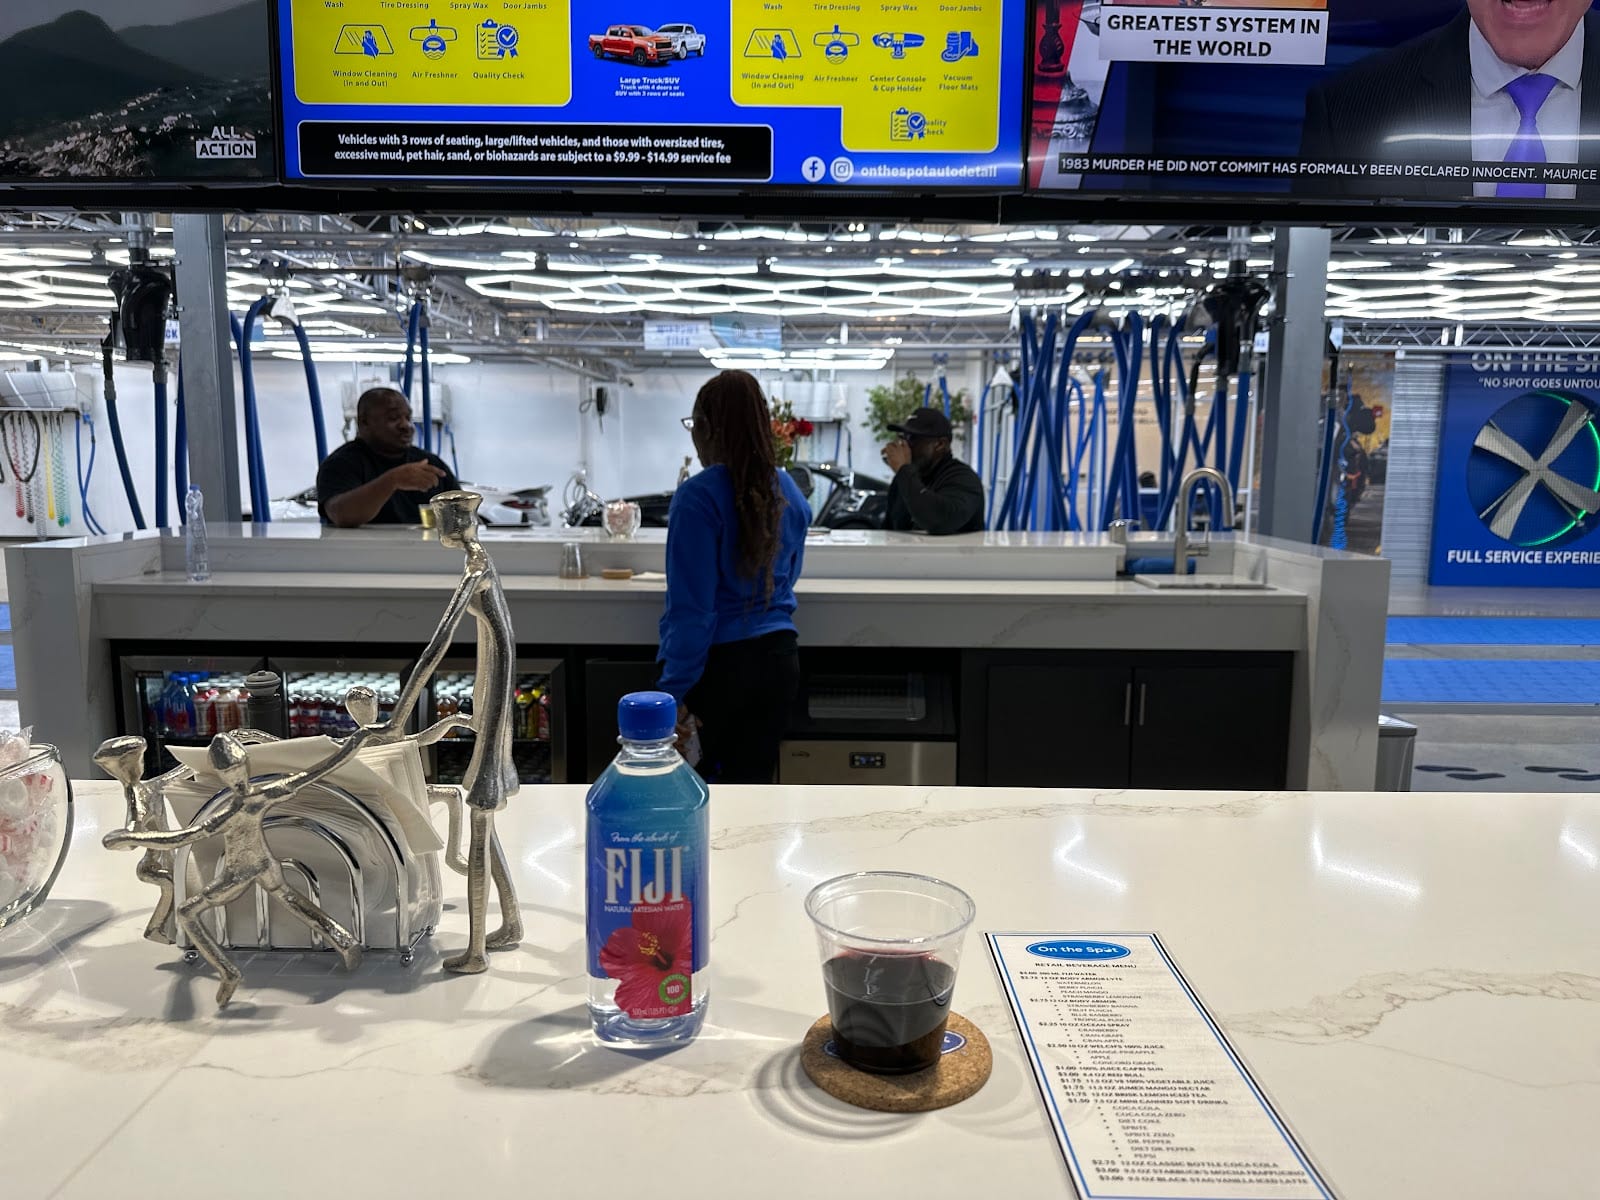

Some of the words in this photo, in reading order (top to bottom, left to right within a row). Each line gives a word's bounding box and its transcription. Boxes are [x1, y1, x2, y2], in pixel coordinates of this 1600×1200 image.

[396, 1, 429, 11] Dressing
[450, 2, 470, 11] Spray
[523, 2, 547, 10] Jambs
[764, 3, 782, 11] Wash
[814, 3, 826, 11] Tire
[827, 3, 860, 12] Dressing
[880, 4, 899, 12] Spray
[939, 4, 957, 12] Door
[959, 4, 982, 12] Jambs
[1107, 14, 1211, 34] GREATEST
[1215, 15, 1295, 35] SYSTEM
[1300, 17, 1320, 35] IN
[1153, 38, 1192, 56] THE
[1196, 39, 1272, 58] WORLD
[333, 69, 362, 78] Window
[364, 70, 397, 79] Cleaning
[425, 71, 457, 79] Freshner
[473, 71, 500, 80] Quality
[502, 71, 525, 79] Check
[742, 72, 770, 80] Window
[772, 72, 804, 82] Cleaning
[814, 74, 825, 82] Air
[826, 74, 858, 83] Freshner
[870, 74, 894, 83] Center
[896, 75, 926, 83] Console
[943, 74, 973, 82] Vacuum
[620, 77, 641, 85] Large
[642, 76, 680, 85] Truck/SUV
[881, 84, 895, 94] Cup
[897, 85, 922, 93] Holder
[939, 83, 958, 91] Floor
[960, 83, 978, 91] Mats
[925, 119, 947, 128] uality
[211, 125, 240, 139] ALL
[338, 134, 377, 145] Vehicles
[379, 134, 400, 145] with
[402, 134, 408, 145] 3
[410, 135, 432, 145] rows
[434, 134, 445, 145] of
[446, 134, 483, 147] seating,
[485, 135, 539, 147] large/lifted
[540, 136, 580, 148] vehicles,
[582, 136, 600, 147] and
[602, 136, 629, 147] those
[631, 136, 652, 147] with
[653, 137, 699, 148] oversized
[701, 137, 725, 149] tires,
[199, 141, 254, 157] ACTION
[334, 150, 379, 160] excessive
[380, 150, 404, 162] mud,
[406, 151, 422, 162] pet
[424, 150, 445, 161] hair,
[447, 150, 472, 162] sand,
[474, 152, 485, 161] or
[486, 150, 538, 161] biohazards
[540, 153, 556, 162] are
[557, 151, 592, 164] subject
[594, 152, 604, 162] to
[605, 154, 612, 162] a
[614, 151, 640, 163] $9.99
[647, 152, 679, 163] $14.99
[681, 152, 714, 163] service
[716, 153, 731, 163] fee
[861, 164, 997, 180] onthespotautodetail
[1062, 157, 1089, 170] 1983
[1092, 158, 1145, 172] MURDER
[1148, 160, 1164, 172] HE
[1167, 160, 1188, 173] DID
[1190, 161, 1217, 174] NOT
[1219, 161, 1271, 175] COMMIT
[1273, 163, 1298, 175] HAS
[1300, 163, 1367, 177] FORMALLY
[1370, 165, 1402, 177] BEEN
[1405, 166, 1470, 178] DECLARED
[1472, 167, 1537, 179] INNOCENT.
[1543, 168, 1597, 180] MAURICE
[1471, 352, 1511, 372] ON
[1518, 352, 1568, 373] THE
[1503, 377, 1532, 388] SPOT
[1532, 378, 1561, 389] GOES
[1447, 549, 1482, 564] FULL
[1485, 550, 1543, 564] SERVICE
[1545, 551, 1600, 565] EXPERIE
[604, 846, 686, 905] FIJI
[604, 905, 632, 913] NATURAL
